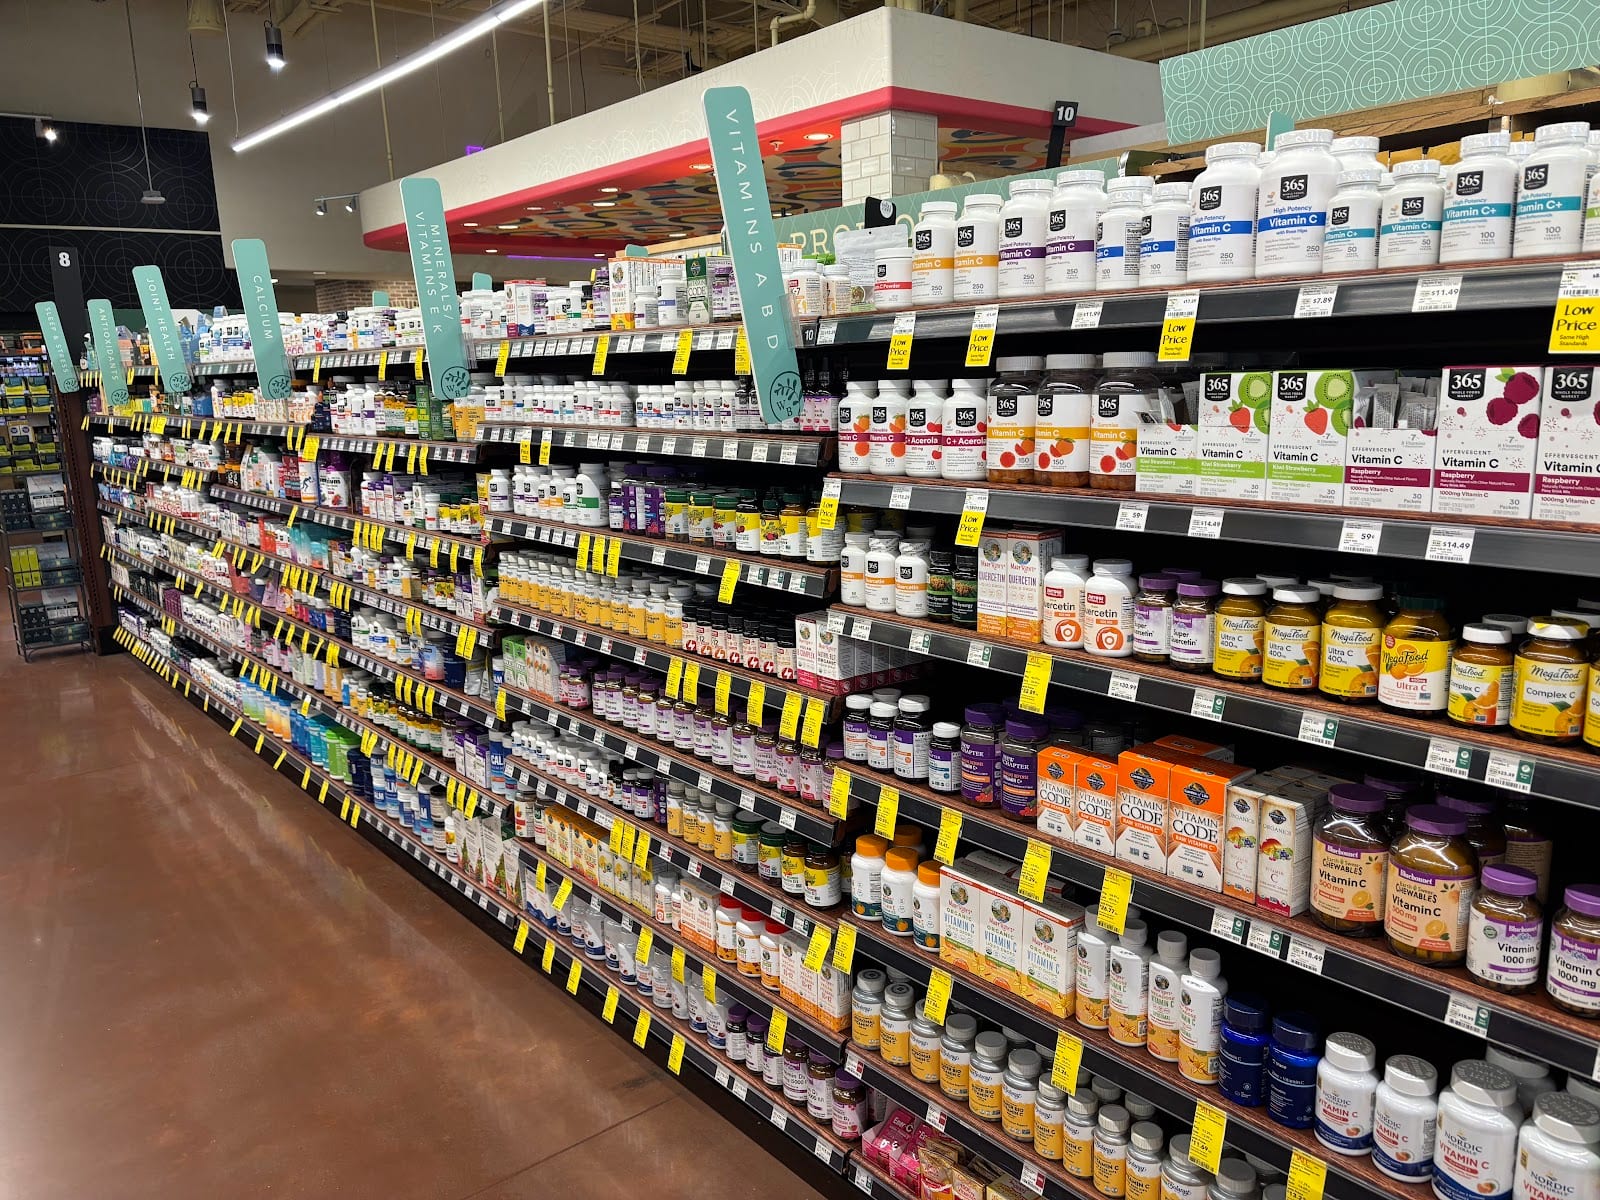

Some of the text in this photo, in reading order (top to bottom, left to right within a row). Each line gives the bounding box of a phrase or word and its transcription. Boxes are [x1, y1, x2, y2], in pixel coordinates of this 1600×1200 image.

[1056, 106, 1075, 122] 10
[1459, 174, 1481, 189] 365
[1525, 168, 1546, 183] 365
[1282, 178, 1305, 194] 365
[1201, 190, 1219, 203] 365
[1273, 204, 1313, 215] High Potency
[1403, 199, 1423, 211] 365
[1480, 206, 1497, 215] C+
[1050, 214, 1065, 226] 365
[1268, 214, 1318, 229] Vitamin C
[1332, 209, 1348, 221] 365
[724, 107, 781, 349] VITAMINS A B D
[1006, 222, 1021, 233] 365
[1391, 224, 1421, 232] Vitamin
[1544, 226, 1561, 234] 100
[917, 234, 931, 245] 365
[958, 230, 974, 243] 365
[1480, 231, 1496, 239] 100
[415, 211, 438, 297] VITAMINS
[1306, 244, 1321, 253] 250
[58, 252, 71, 268] 8
[1219, 252, 1234, 260] 250
[430, 223, 455, 321] MINERALS/
[1430, 287, 1459, 297] $11.49
[253, 274, 276, 340] CALCIUM
[1563, 304, 1594, 318] Low
[146, 277, 176, 361] JOINT HEALTH
[1555, 318, 1598, 332] Price
[1167, 323, 1186, 334] Low
[804, 329, 815, 342] 10
[973, 333, 989, 344] Low
[1162, 334, 1188, 347] Price
[99, 308, 120, 382] ANTIOXIDANTS
[969, 343, 989, 354] Price
[1206, 376, 1229, 391] 365
[1280, 376, 1304, 392] 365
[1451, 371, 1482, 389] 365
[1554, 371, 1590, 389] 365
[999, 399, 1015, 411] 365
[1100, 399, 1117, 411] 365
[873, 409, 887, 419] 365
[909, 412, 925, 424] 365
[957, 411, 975, 423] 365
[991, 429, 1025, 437] Vitamin C
[911, 435, 938, 445] Acerola
[1140, 446, 1177, 456] Vitamin C
[1201, 449, 1244, 459] Vitamin C
[1273, 451, 1319, 462] Vitamin C
[1443, 448, 1492, 456] EFFERVESCENT
[1119, 461, 1132, 469] 150
[1351, 454, 1404, 465] Vitamin C
[1442, 456, 1500, 469] Vitamin C
[1284, 465, 1317, 473] Strawberry
[1350, 467, 1382, 476] Raspberry
[1543, 460, 1593, 473] Vitamin
[1440, 471, 1476, 480] Raspberry
[1542, 477, 1581, 486] Raspberry
[1440, 489, 1484, 498] 1000mg Vitamin
[1540, 496, 1591, 505] 1000mg Vitamin
[964, 514, 978, 524] Low
[959, 523, 979, 534] Price
[1443, 541, 1471, 551] $14.49
[1008, 574, 1037, 586] QUERCETIN
[1222, 616, 1260, 630] MegaFood
[1220, 632, 1243, 643] Ultra C
[1271, 625, 1309, 641] MegaFood
[1329, 629, 1373, 645] MegaFood
[1268, 641, 1292, 652] Ultra C
[1328, 646, 1354, 658] Ultra C
[1381, 649, 1430, 666] MegaFood
[1529, 663, 1582, 682] MegaFood
[1396, 681, 1427, 693] Ultra C
[1525, 686, 1577, 700] Complex C
[1039, 780, 1071, 797] VITAMIN
[1038, 789, 1072, 808] CODE
[1078, 790, 1113, 808] VITAMIN
[1121, 792, 1164, 812] VITAMIN
[1077, 798, 1113, 821] CODE
[1120, 802, 1164, 827] CODE
[1173, 807, 1219, 830] VITAMIN
[1172, 818, 1219, 845] CODE
[1326, 845, 1360, 858] Bluebonnet
[1321, 857, 1364, 876] CHEWABLES
[1319, 870, 1367, 889] Vitamin C
[1400, 869, 1434, 886] Bluebonnet
[1318, 880, 1345, 895] 500 mg
[1394, 884, 1438, 904] CHEWABLES
[1391, 895, 1442, 918] Vitamin C
[944, 911, 969, 931] VITAMIN
[1391, 906, 1418, 923] 500 mg
[986, 924, 1015, 941] ORGANIC
[984, 929, 1011, 951] VITAMIN
[1029, 944, 1057, 962] ORGANIC
[1496, 941, 1536, 954] Vitamin
[1562, 939, 1599, 956] Bluebonnet
[1300, 948, 1323, 962] $18.49
[1501, 954, 1538, 967] 1000 mg
[1027, 950, 1061, 975] VITAMIN C
[1554, 954, 1594, 978] Vitamin
[1556, 968, 1597, 991] 1000 mg
[1317, 1098, 1359, 1119] VITAMIN C
[1444, 1131, 1484, 1154] NORDIC
[1438, 1141, 1490, 1171] VITAMIN C
[1529, 1170, 1575, 1194] NORDIC
